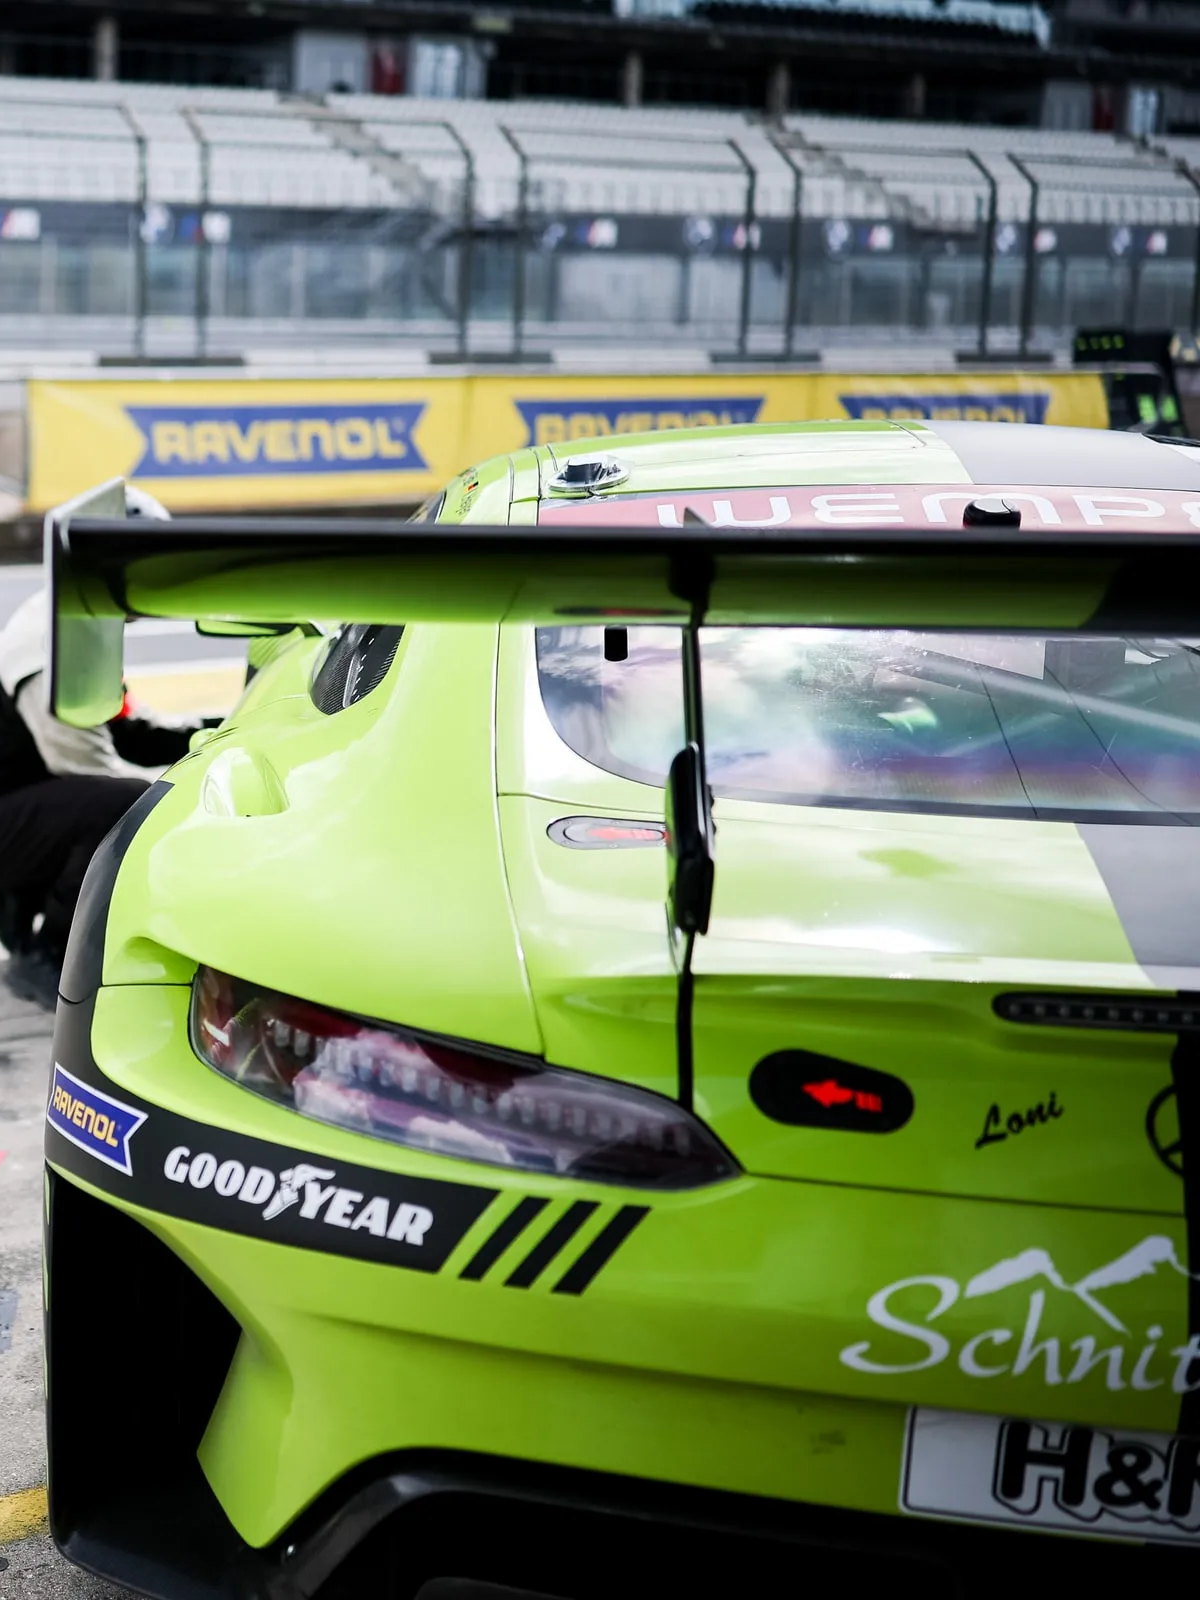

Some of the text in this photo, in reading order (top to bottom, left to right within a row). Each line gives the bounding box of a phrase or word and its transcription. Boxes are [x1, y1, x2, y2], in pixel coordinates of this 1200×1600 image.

[150, 416, 407, 464] RAVENOL
[656, 491, 1200, 529] WEMP
[52, 1084, 119, 1148] RAVENOL
[975, 1092, 1064, 1150] Loni
